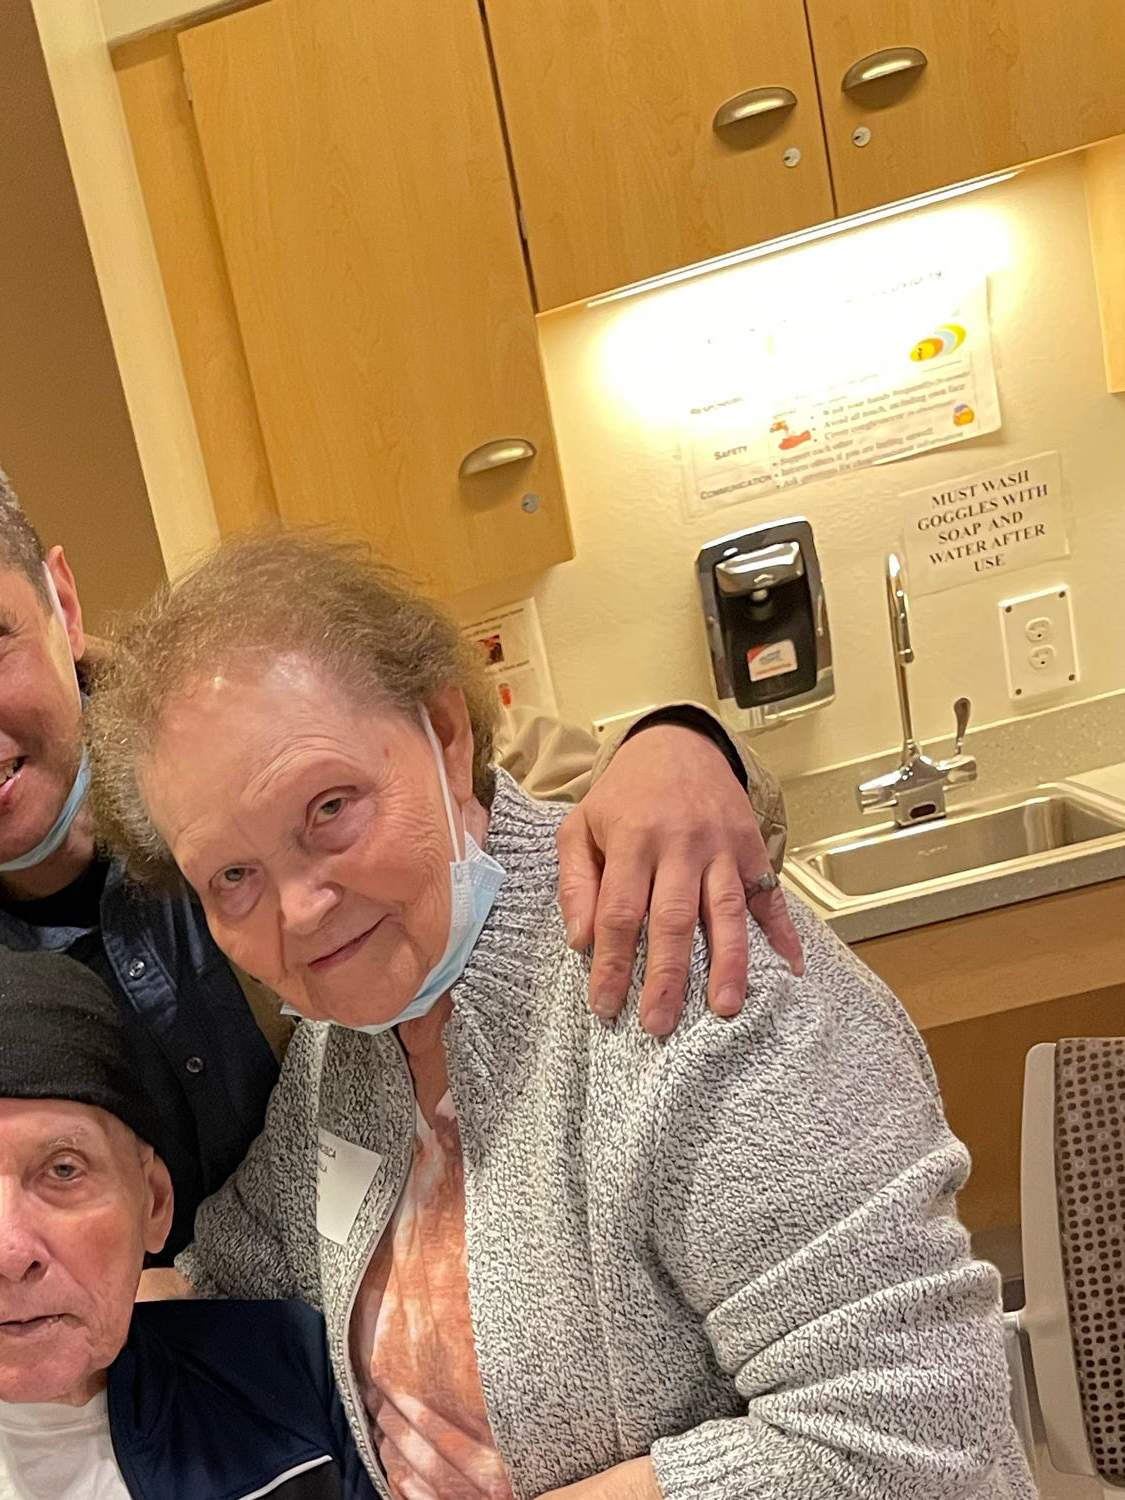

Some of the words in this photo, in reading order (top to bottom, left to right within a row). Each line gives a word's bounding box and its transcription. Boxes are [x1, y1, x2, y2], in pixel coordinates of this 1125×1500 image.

[917, 497, 998, 531] GOGGLES
[1002, 483, 1048, 506] WITH
[932, 484, 978, 508] MUST
[982, 469, 1030, 491] WASH
[929, 540, 987, 565] WATER
[991, 523, 1046, 549] AFTER
[938, 522, 982, 545] SOAP
[988, 511, 1023, 532] AND
[974, 553, 1006, 572] USE
